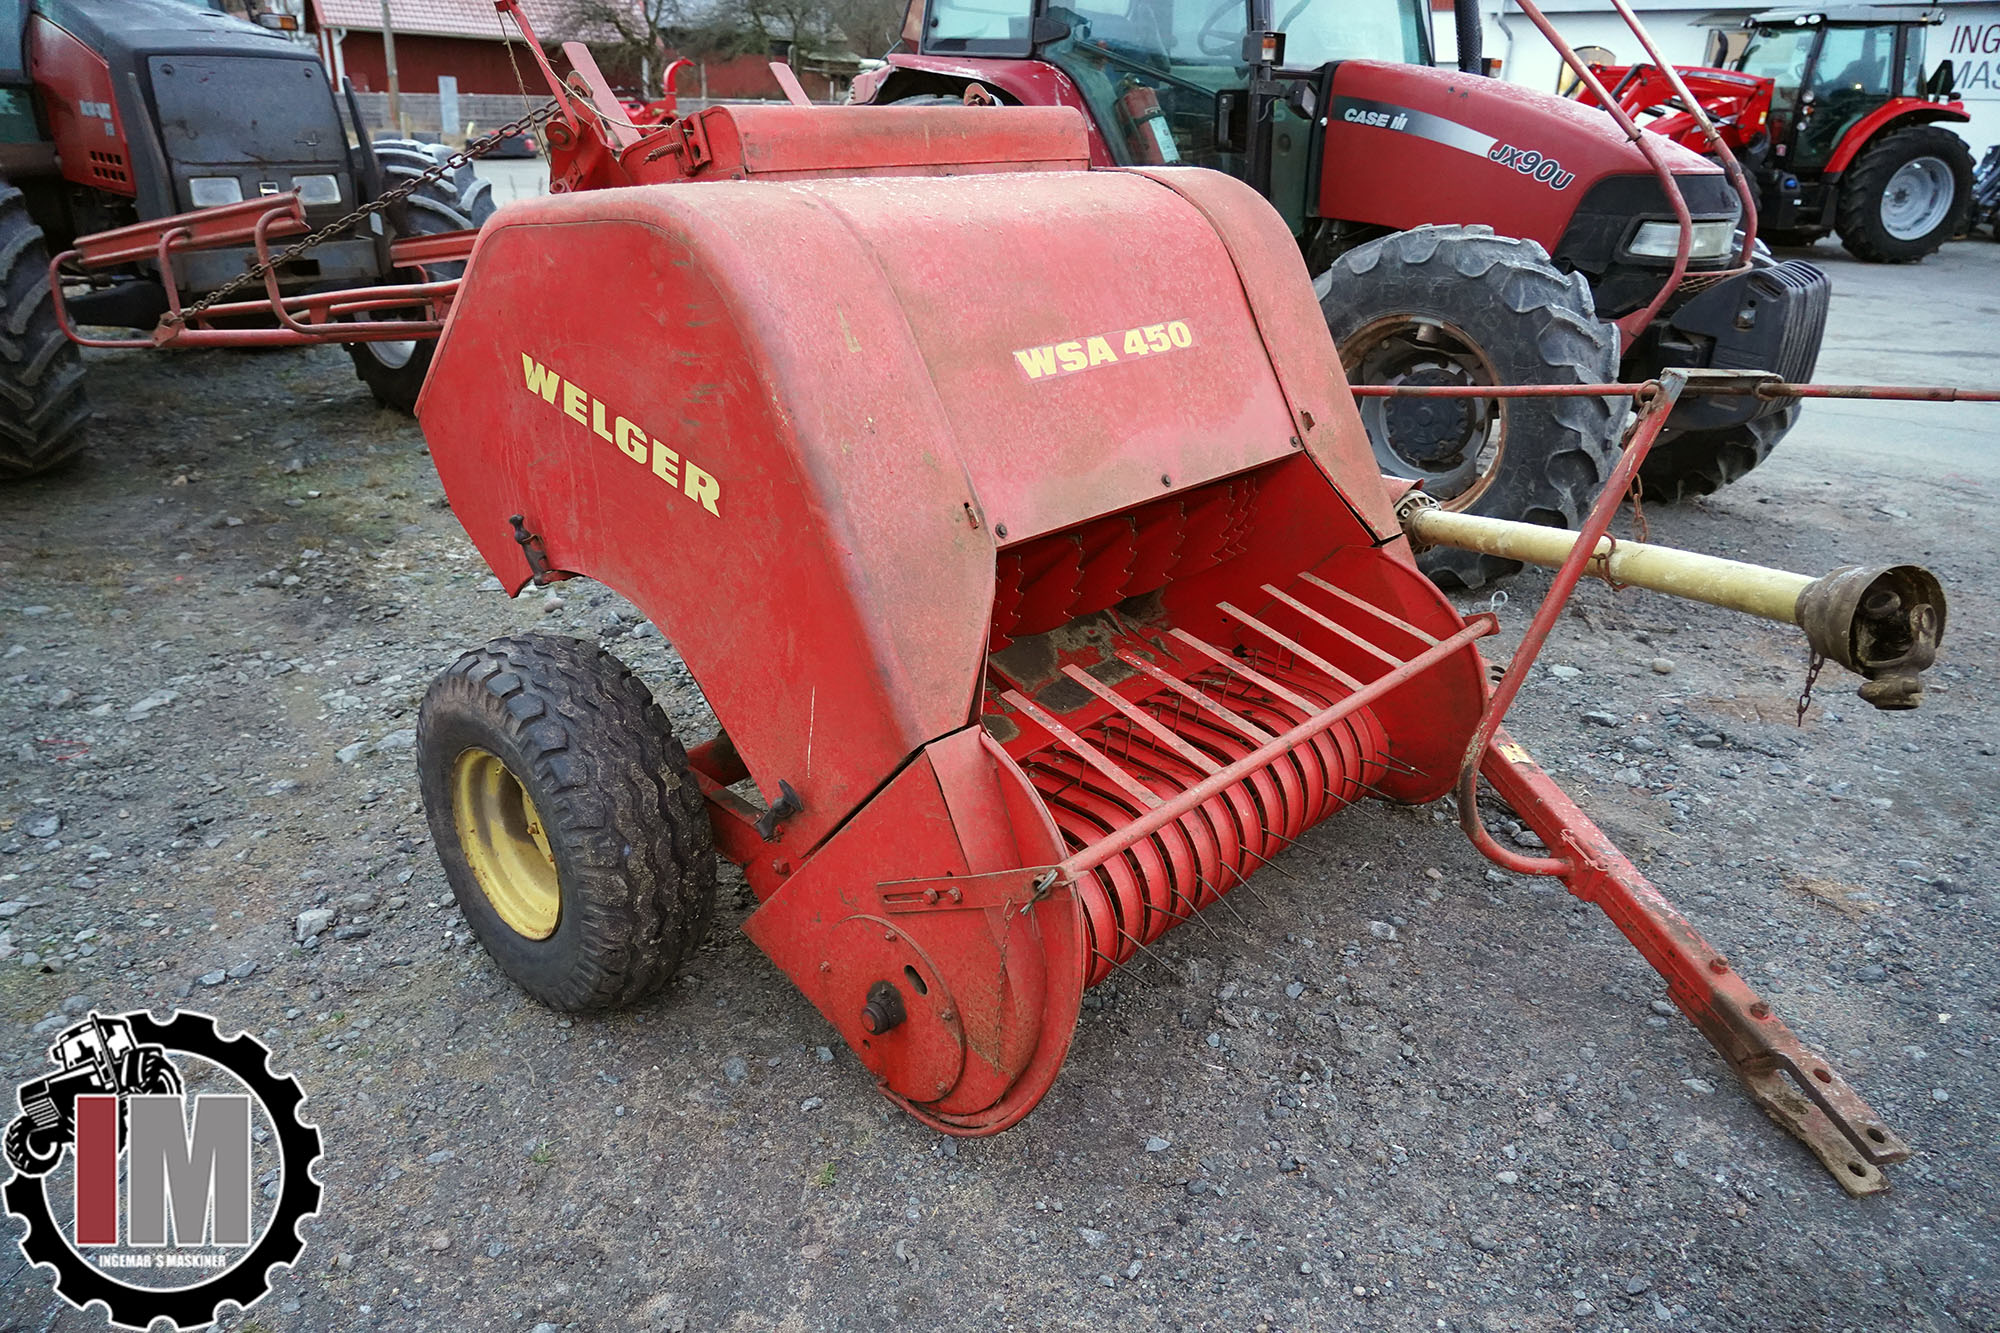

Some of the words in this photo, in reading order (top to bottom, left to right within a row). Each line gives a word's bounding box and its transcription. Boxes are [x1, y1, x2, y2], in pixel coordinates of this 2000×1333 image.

[1344, 107, 1391, 128] CASE
[1013, 336, 1119, 380] WSA
[1123, 321, 1193, 356] 450
[521, 352, 721, 519] WELGER
